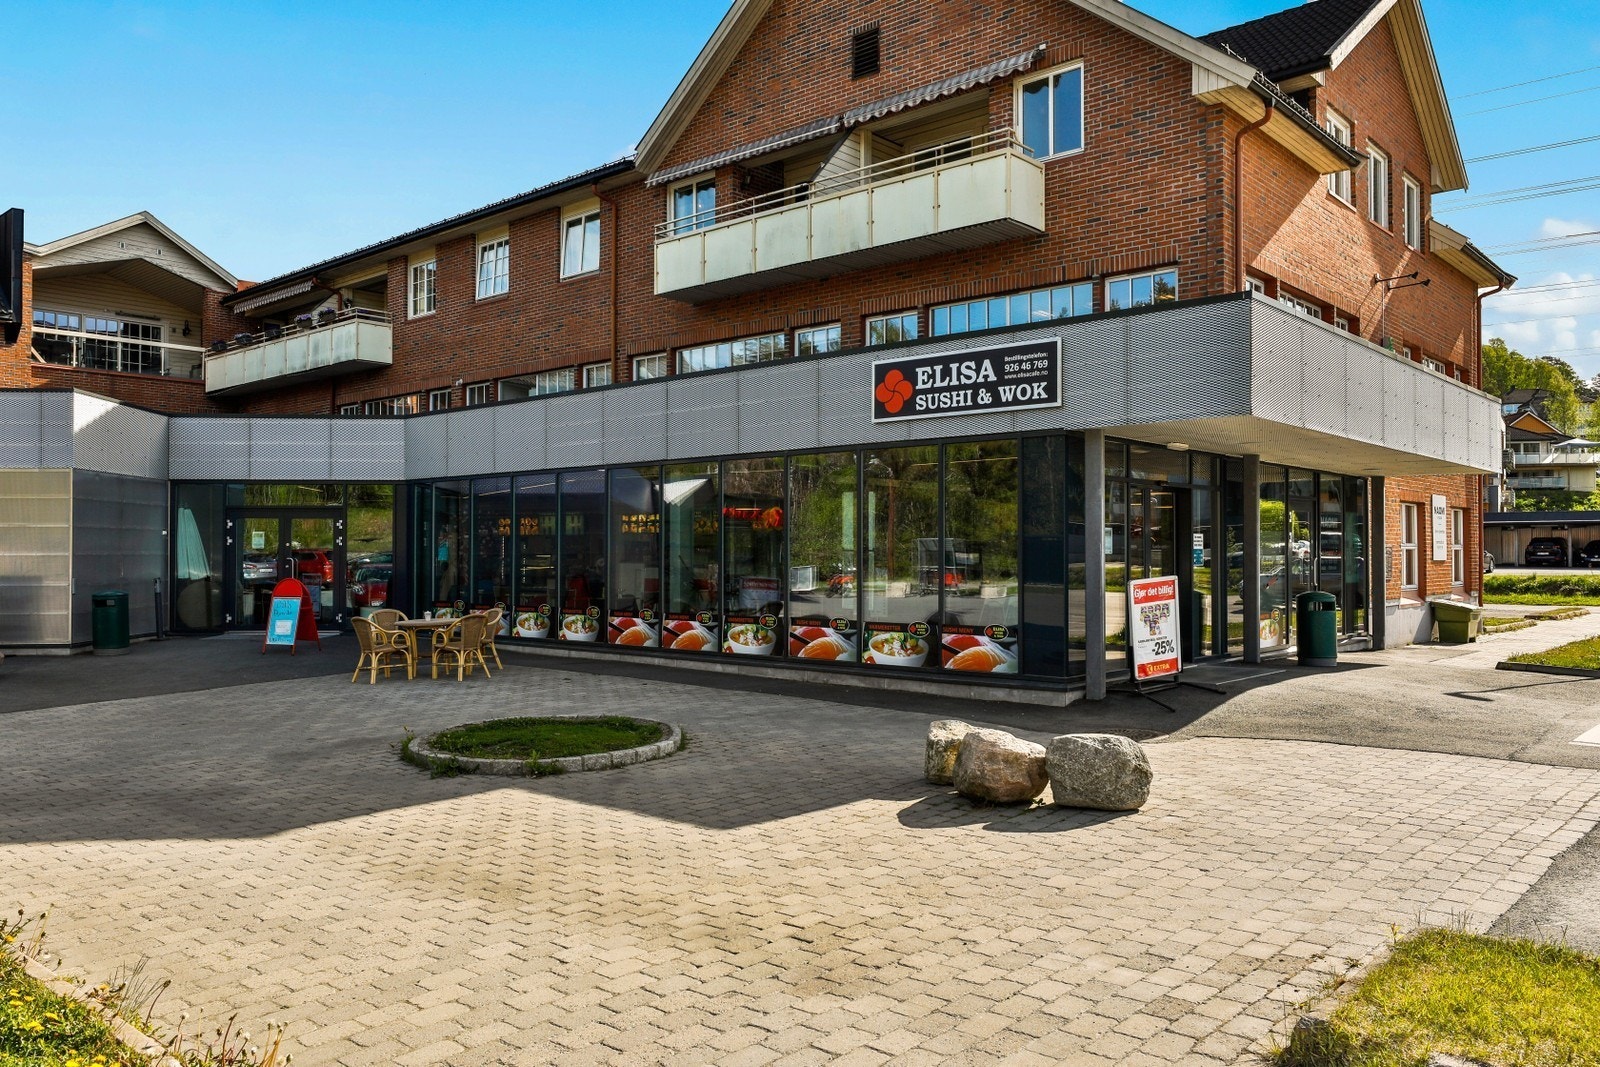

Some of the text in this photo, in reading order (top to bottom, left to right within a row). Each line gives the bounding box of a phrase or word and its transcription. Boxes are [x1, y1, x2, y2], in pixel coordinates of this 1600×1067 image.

[1004, 352, 1048, 361] Bestillingstelefon:
[1004, 359, 1048, 372] 926 46 769
[915, 359, 997, 390] ELISA
[1004, 370, 1049, 379] www.elisacafe.no
[915, 382, 1048, 411] SUSHI & WOK
[1134, 585, 1174, 599] Gjør det billig!
[1152, 639, 1175, 655] -25%
[1153, 663, 1170, 671] EXTRA
